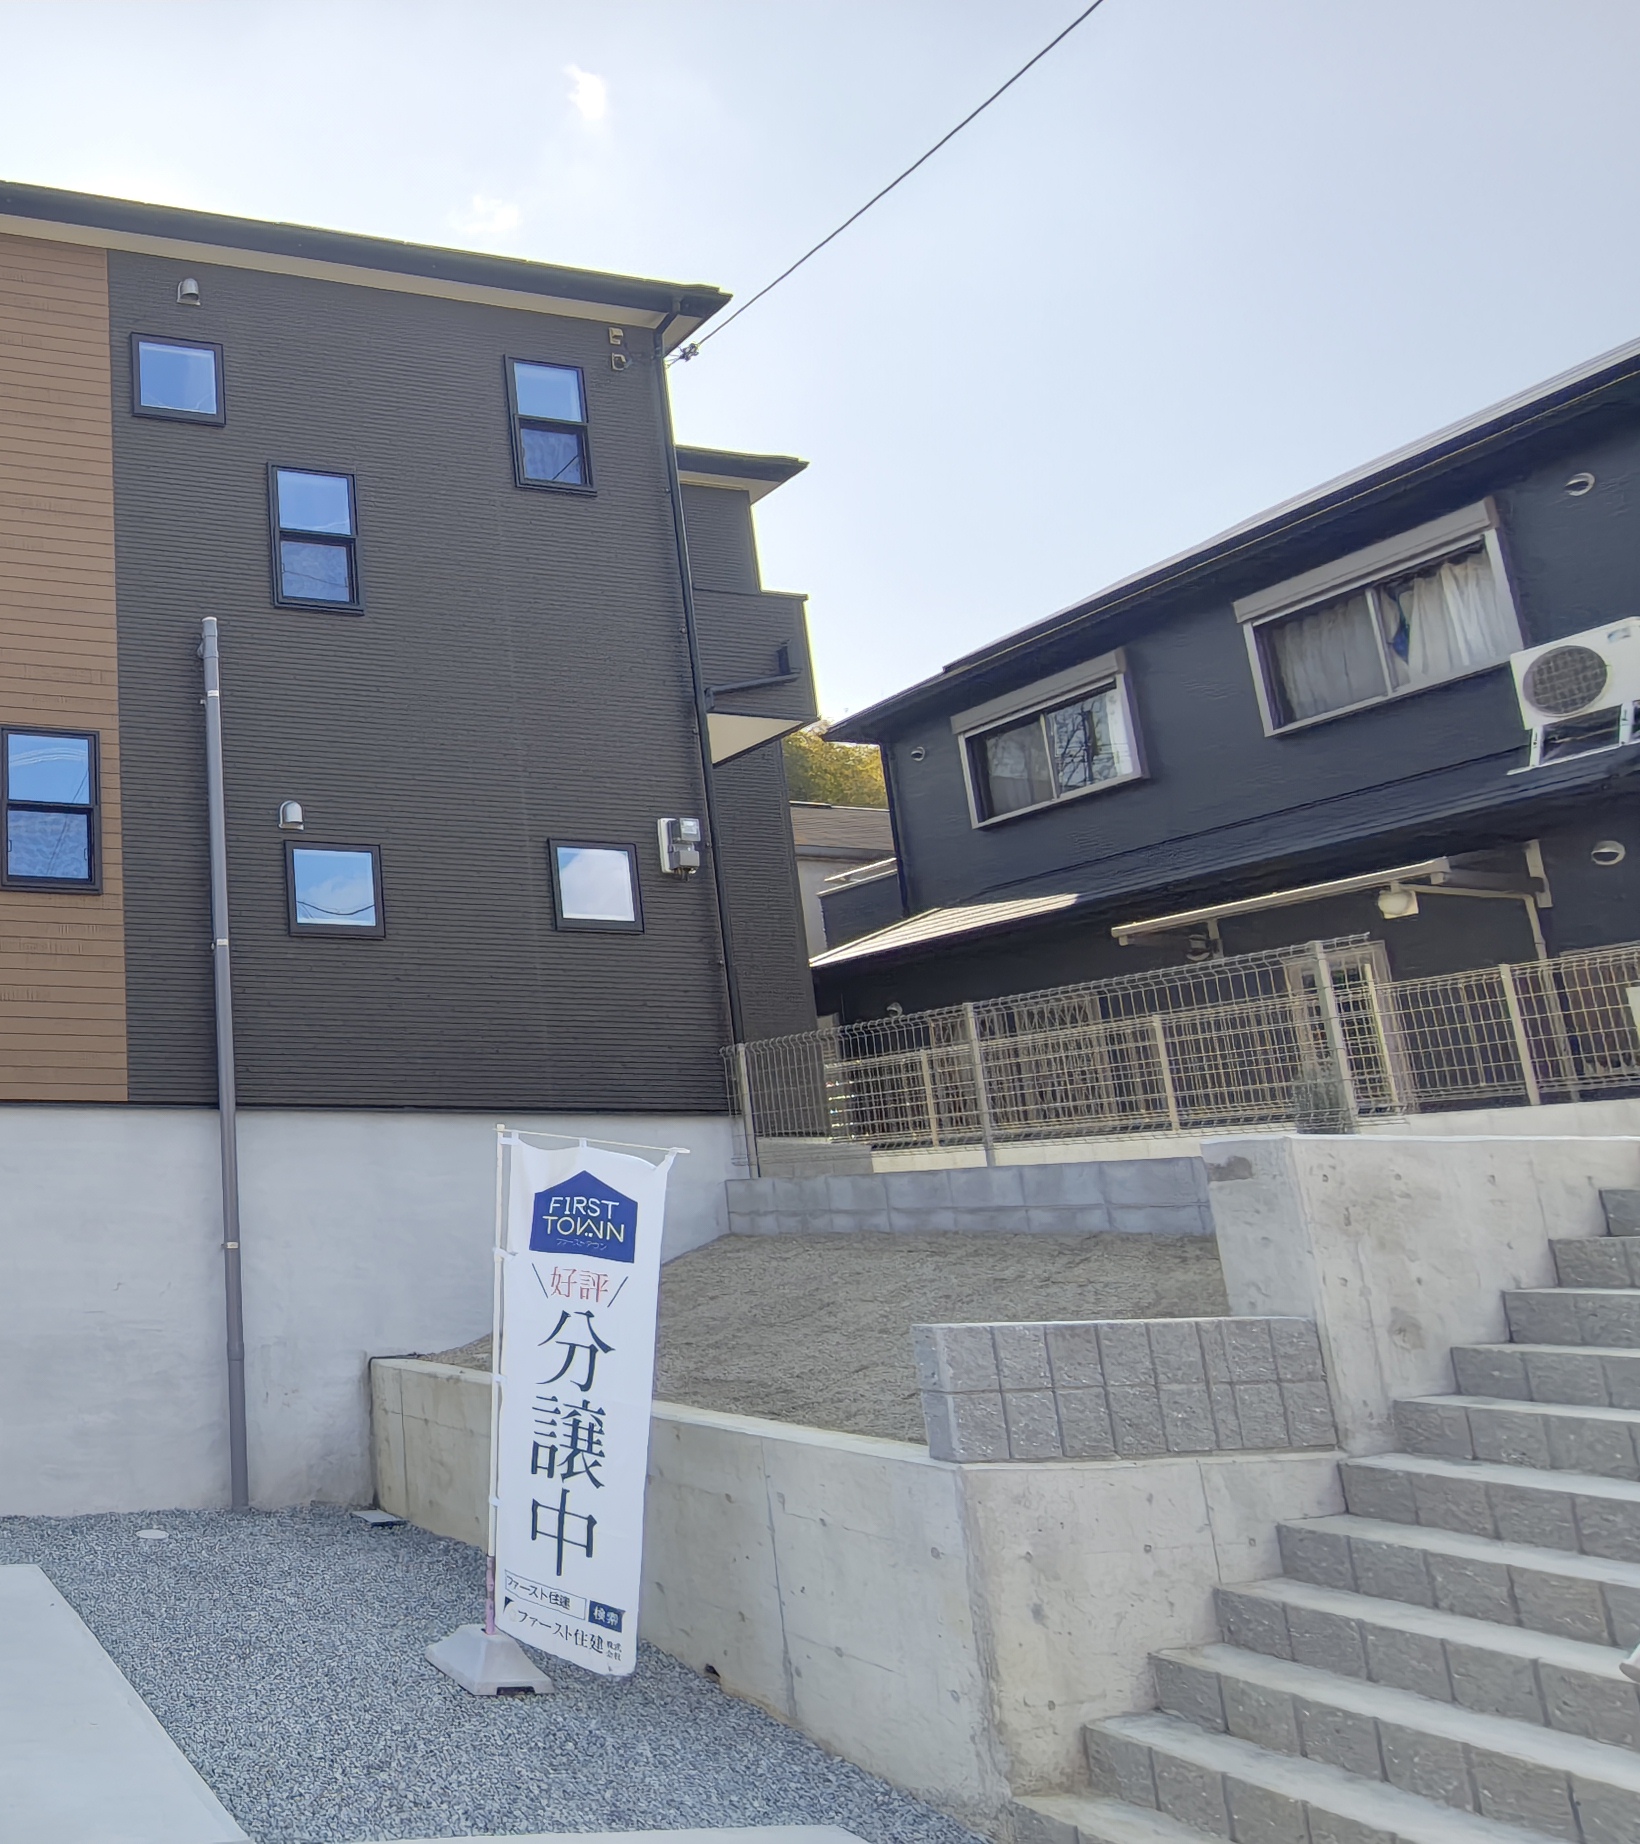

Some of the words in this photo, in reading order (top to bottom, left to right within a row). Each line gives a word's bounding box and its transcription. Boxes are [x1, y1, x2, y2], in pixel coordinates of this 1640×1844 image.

[549, 1196, 620, 1219] FIRST
[542, 1216, 625, 1243] TOWN
[550, 1266, 609, 1303] 好評
[530, 1310, 616, 1577] 分譲中
[517, 1610, 604, 1654] ファースト住建
